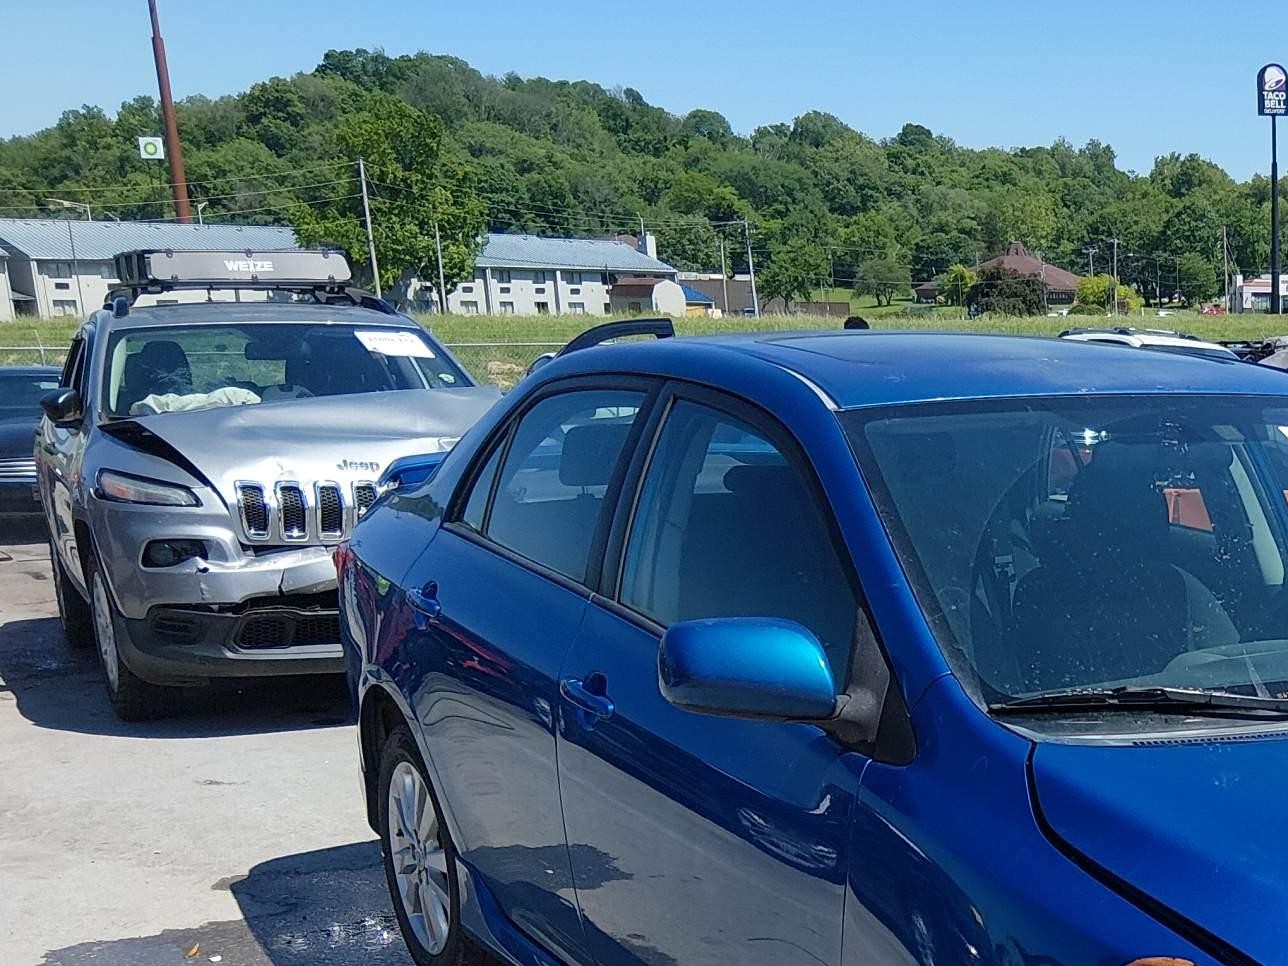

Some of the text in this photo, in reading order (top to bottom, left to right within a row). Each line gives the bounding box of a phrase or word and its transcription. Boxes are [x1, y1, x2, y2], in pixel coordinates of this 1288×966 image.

[1262, 91, 1286, 100] TACO
[1264, 100, 1286, 108] BELL
[223, 260, 274, 272] WEIZE
[336, 459, 380, 472] Jeep
